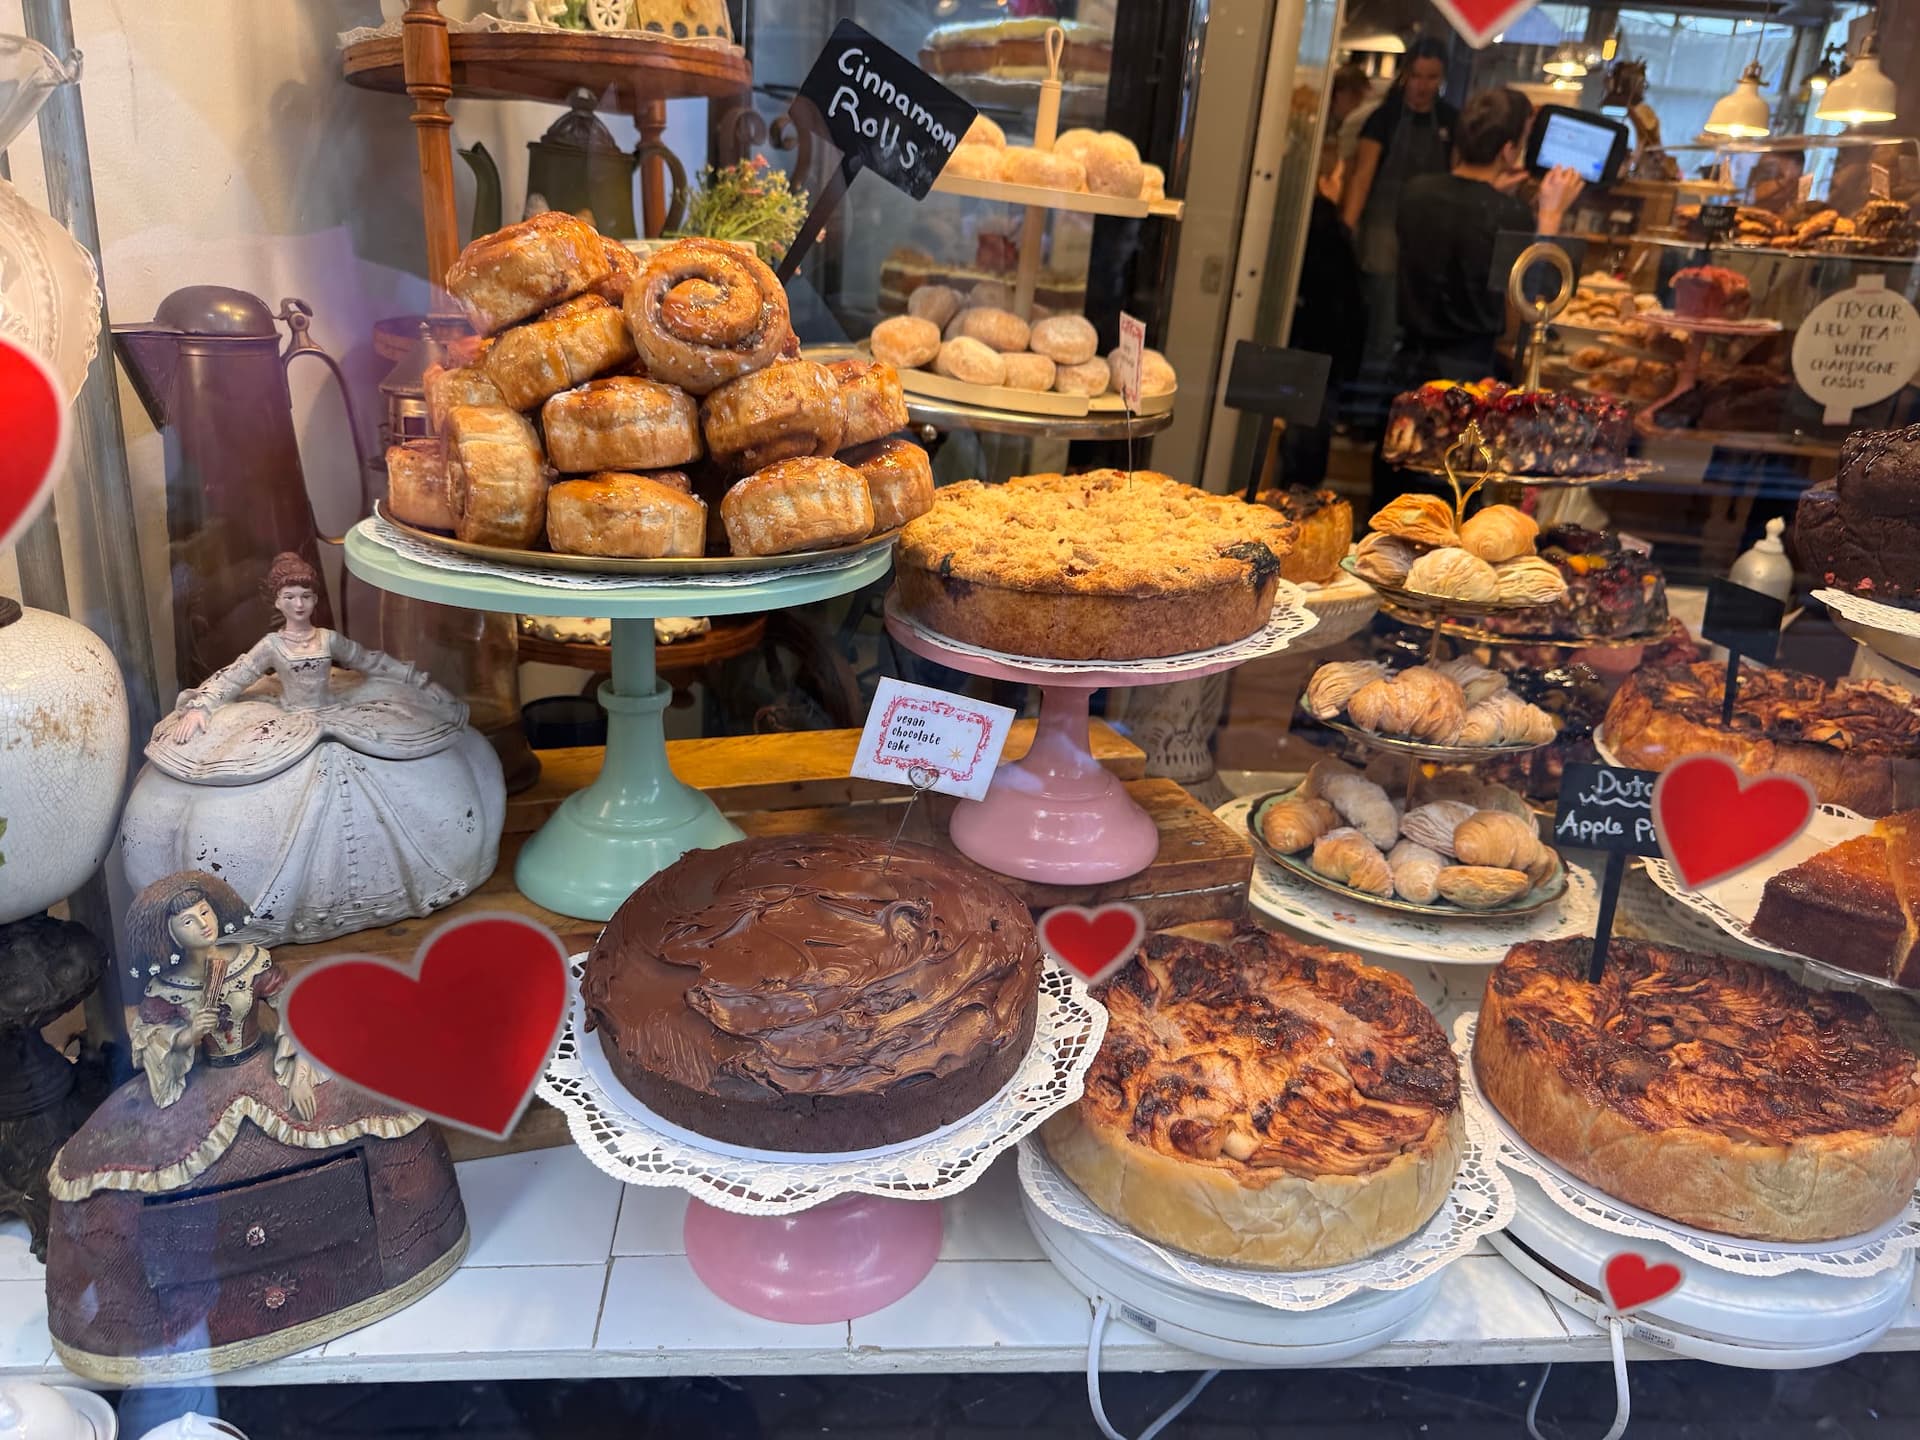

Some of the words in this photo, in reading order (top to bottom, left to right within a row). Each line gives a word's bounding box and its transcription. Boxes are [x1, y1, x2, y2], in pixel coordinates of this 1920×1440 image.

[837, 48, 958, 153] Cinnamon
[828, 85, 919, 170] Rolls
[1836, 301, 1866, 320] TRY
[1813, 322, 1850, 337] NEW
[1834, 343, 1875, 357] WHITE
[1810, 358, 1898, 376] CHAMPAGNE
[1820, 376, 1866, 389] CASSIS
[896, 715, 926, 727] vegan
[892, 726, 941, 745] chocolate
[887, 739, 911, 752] cake
[1591, 769, 1653, 798] Dutc
[1556, 809, 1624, 844] Apple
[1635, 817, 1656, 842] Pi
